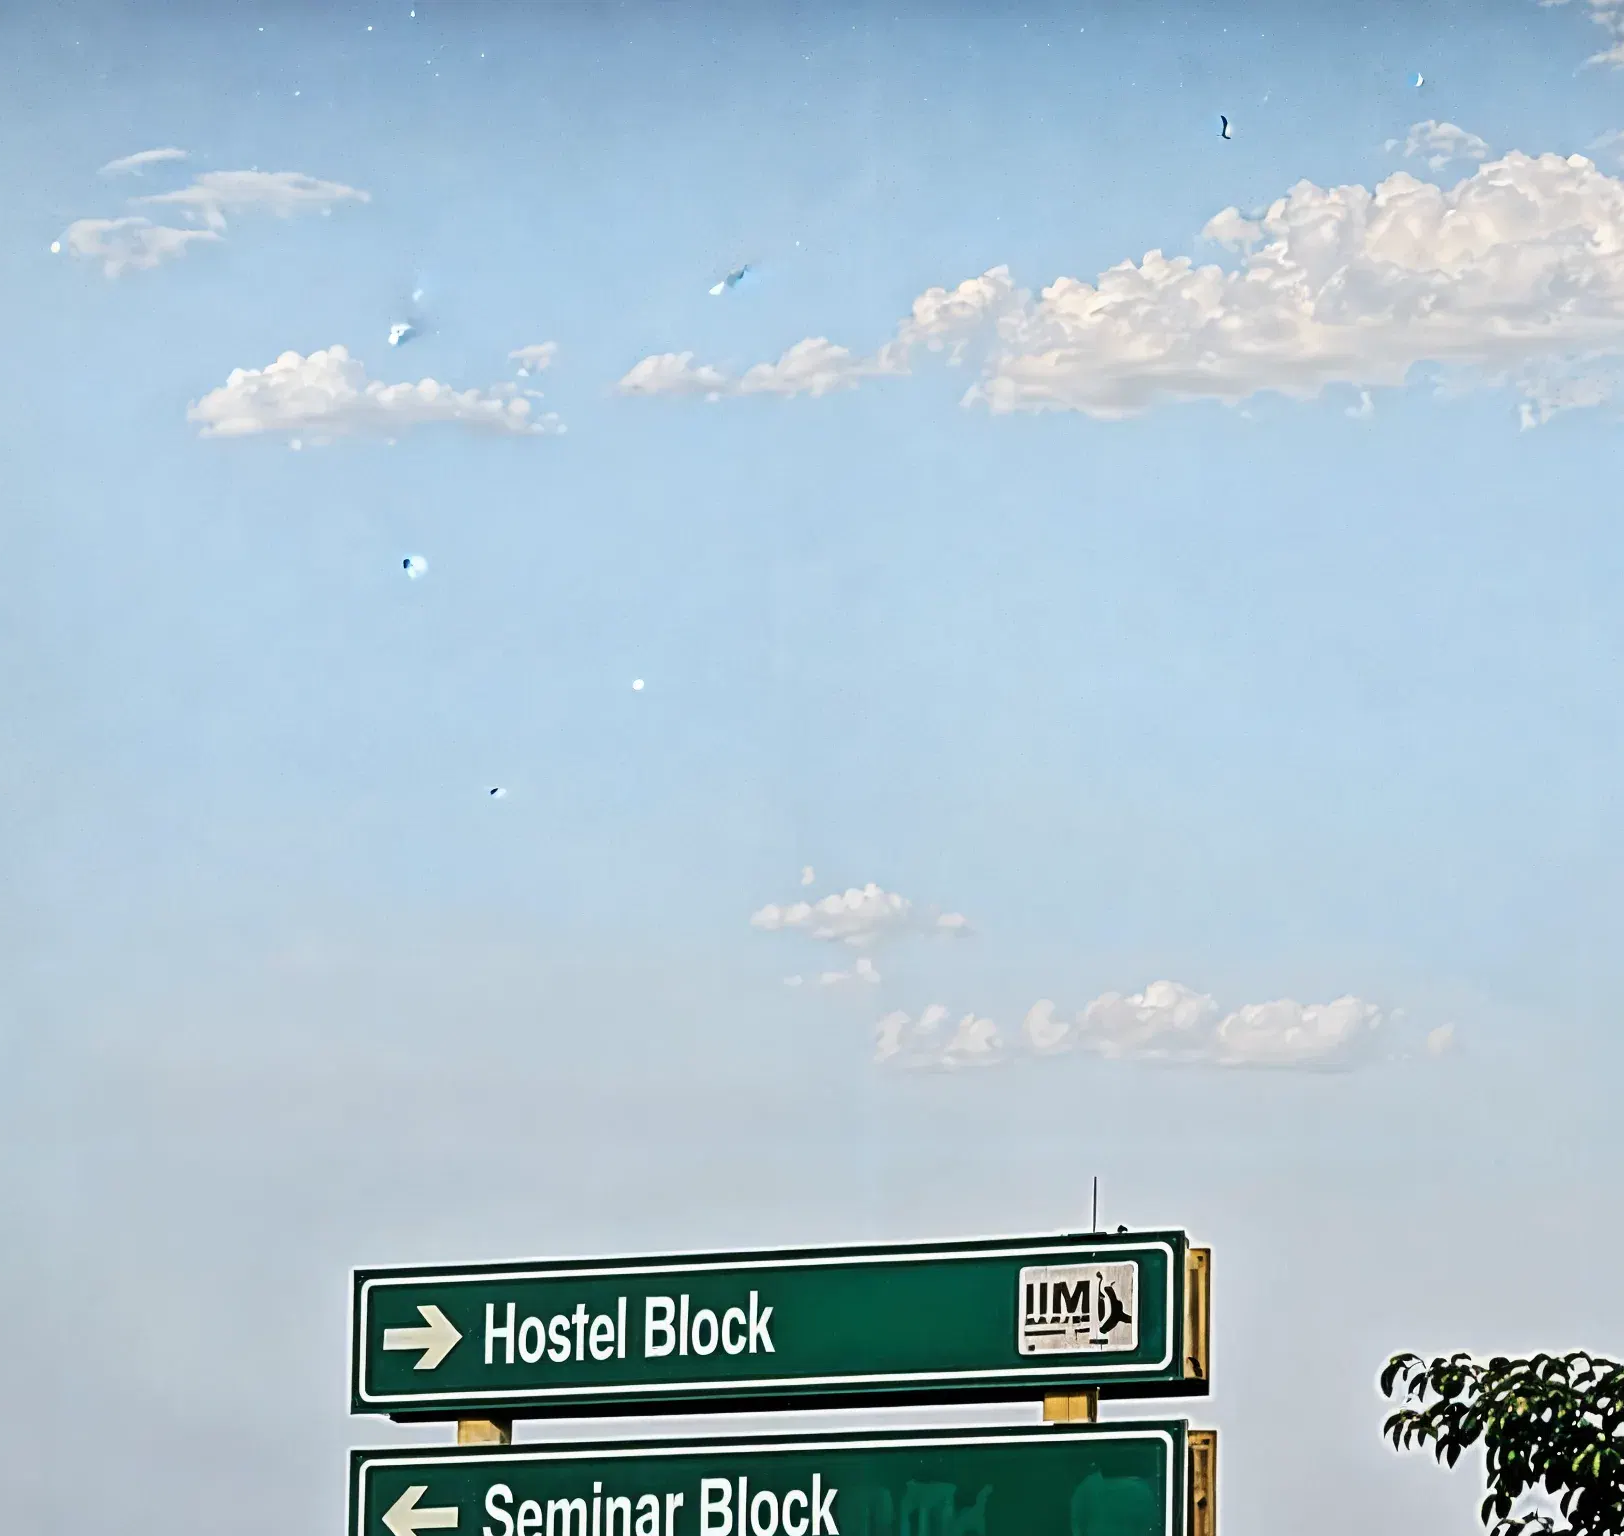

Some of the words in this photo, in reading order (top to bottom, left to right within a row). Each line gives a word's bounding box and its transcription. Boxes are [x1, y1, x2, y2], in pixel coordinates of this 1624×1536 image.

[1026, 1280, 1090, 1314] IIM
[484, 1296, 627, 1364] Hostel
[644, 1290, 776, 1358] Block
